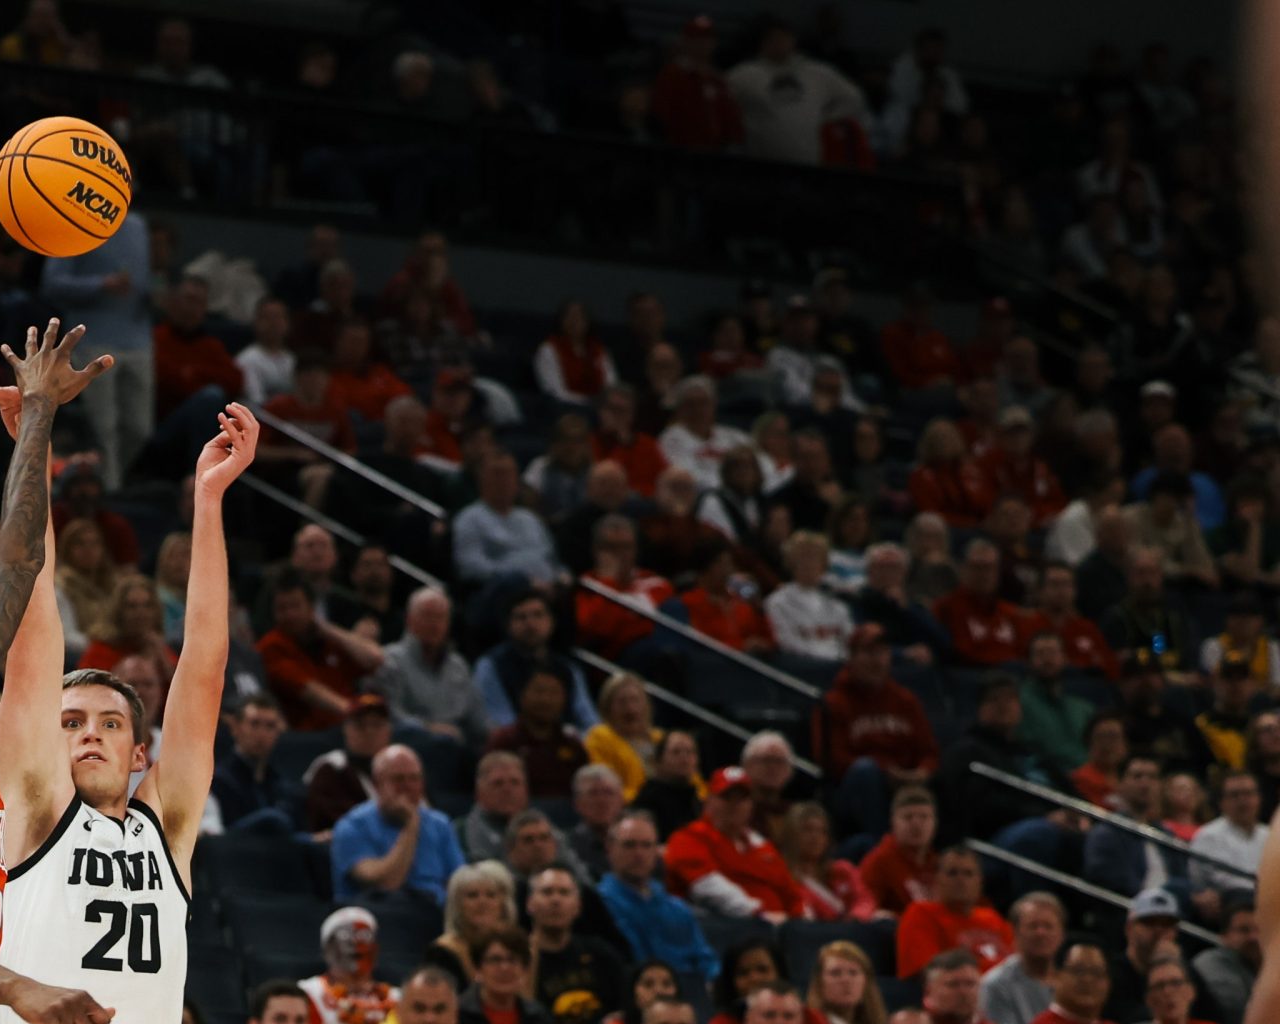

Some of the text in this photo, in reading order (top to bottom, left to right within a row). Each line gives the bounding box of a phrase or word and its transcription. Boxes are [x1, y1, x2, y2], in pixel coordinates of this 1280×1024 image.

[70, 136, 131, 187] Wilso
[67, 181, 120, 224] NCAA
[67, 848, 163, 891] IOWA
[81, 899, 161, 973] 20
